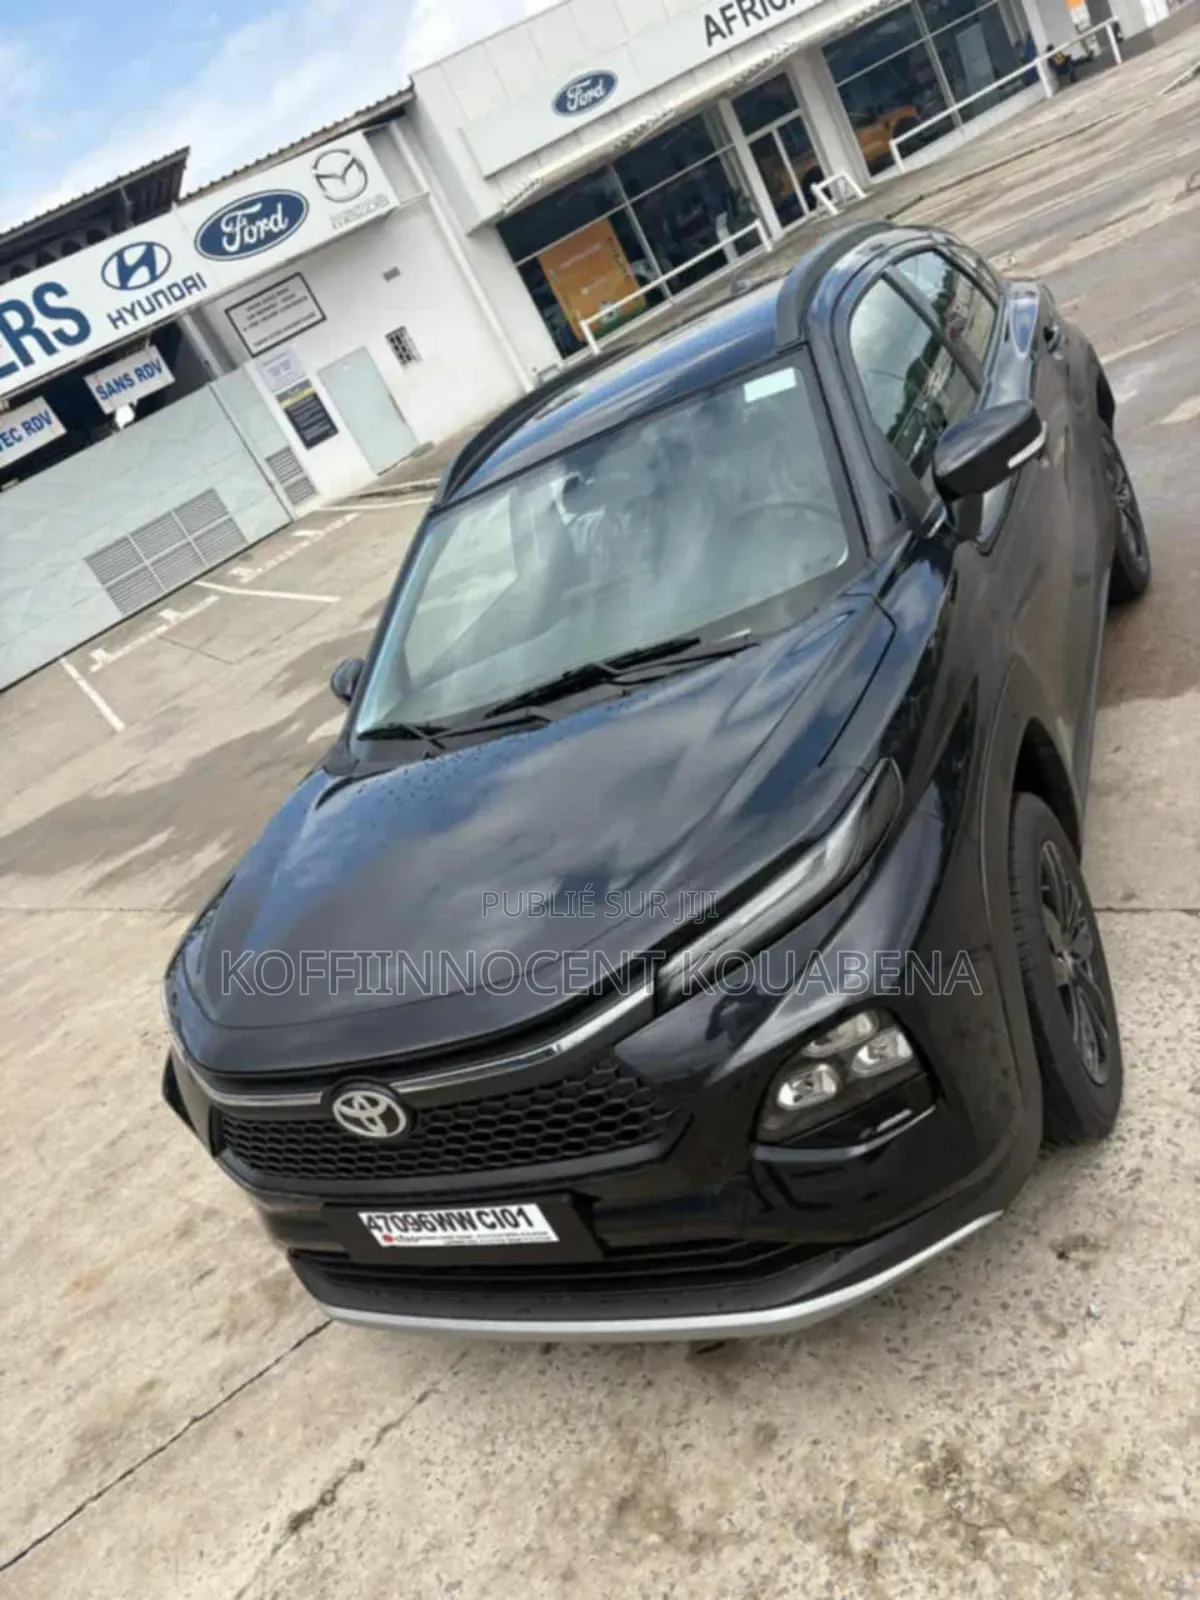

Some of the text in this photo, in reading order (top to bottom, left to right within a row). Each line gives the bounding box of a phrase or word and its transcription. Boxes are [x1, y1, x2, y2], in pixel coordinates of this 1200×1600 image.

[703, 0, 796, 48] AFRI
[566, 79, 606, 111] Ford
[220, 201, 289, 253] Ford
[106, 272, 208, 330] HYUNDAI
[95, 358, 162, 400] SANS RDV
[0, 409, 52, 452] EC RDV
